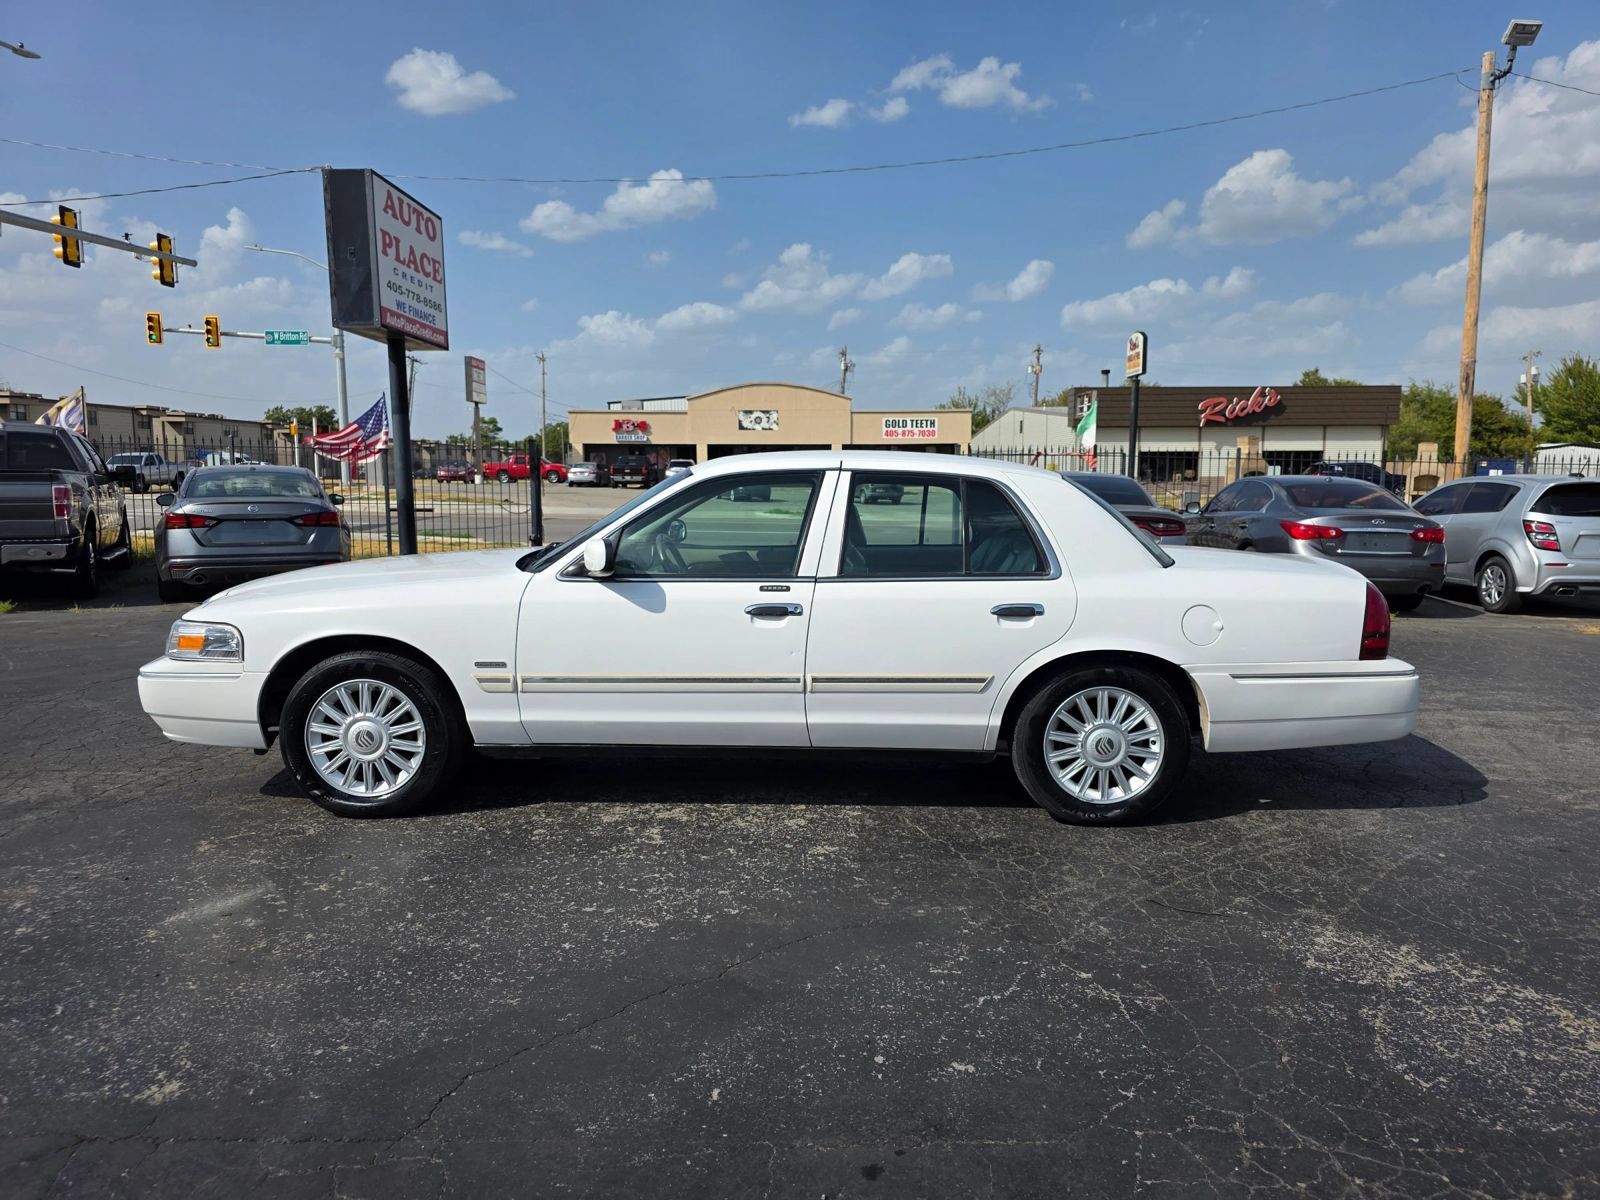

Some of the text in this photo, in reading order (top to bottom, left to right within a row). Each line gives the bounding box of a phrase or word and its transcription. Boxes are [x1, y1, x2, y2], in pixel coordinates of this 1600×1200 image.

[382, 189, 437, 242] AUTO
[379, 227, 443, 284] PLACE
[393, 267, 434, 292] CREDIT
[386, 279, 443, 313] 405-778-8586
[395, 299, 437, 326] WE FINANCE
[273, 331, 308, 341] W Britton Rd
[1197, 386, 1281, 427] Rick's
[884, 429, 936, 438] 405-875-7030
[885, 419, 936, 429] GOLD TEETH
